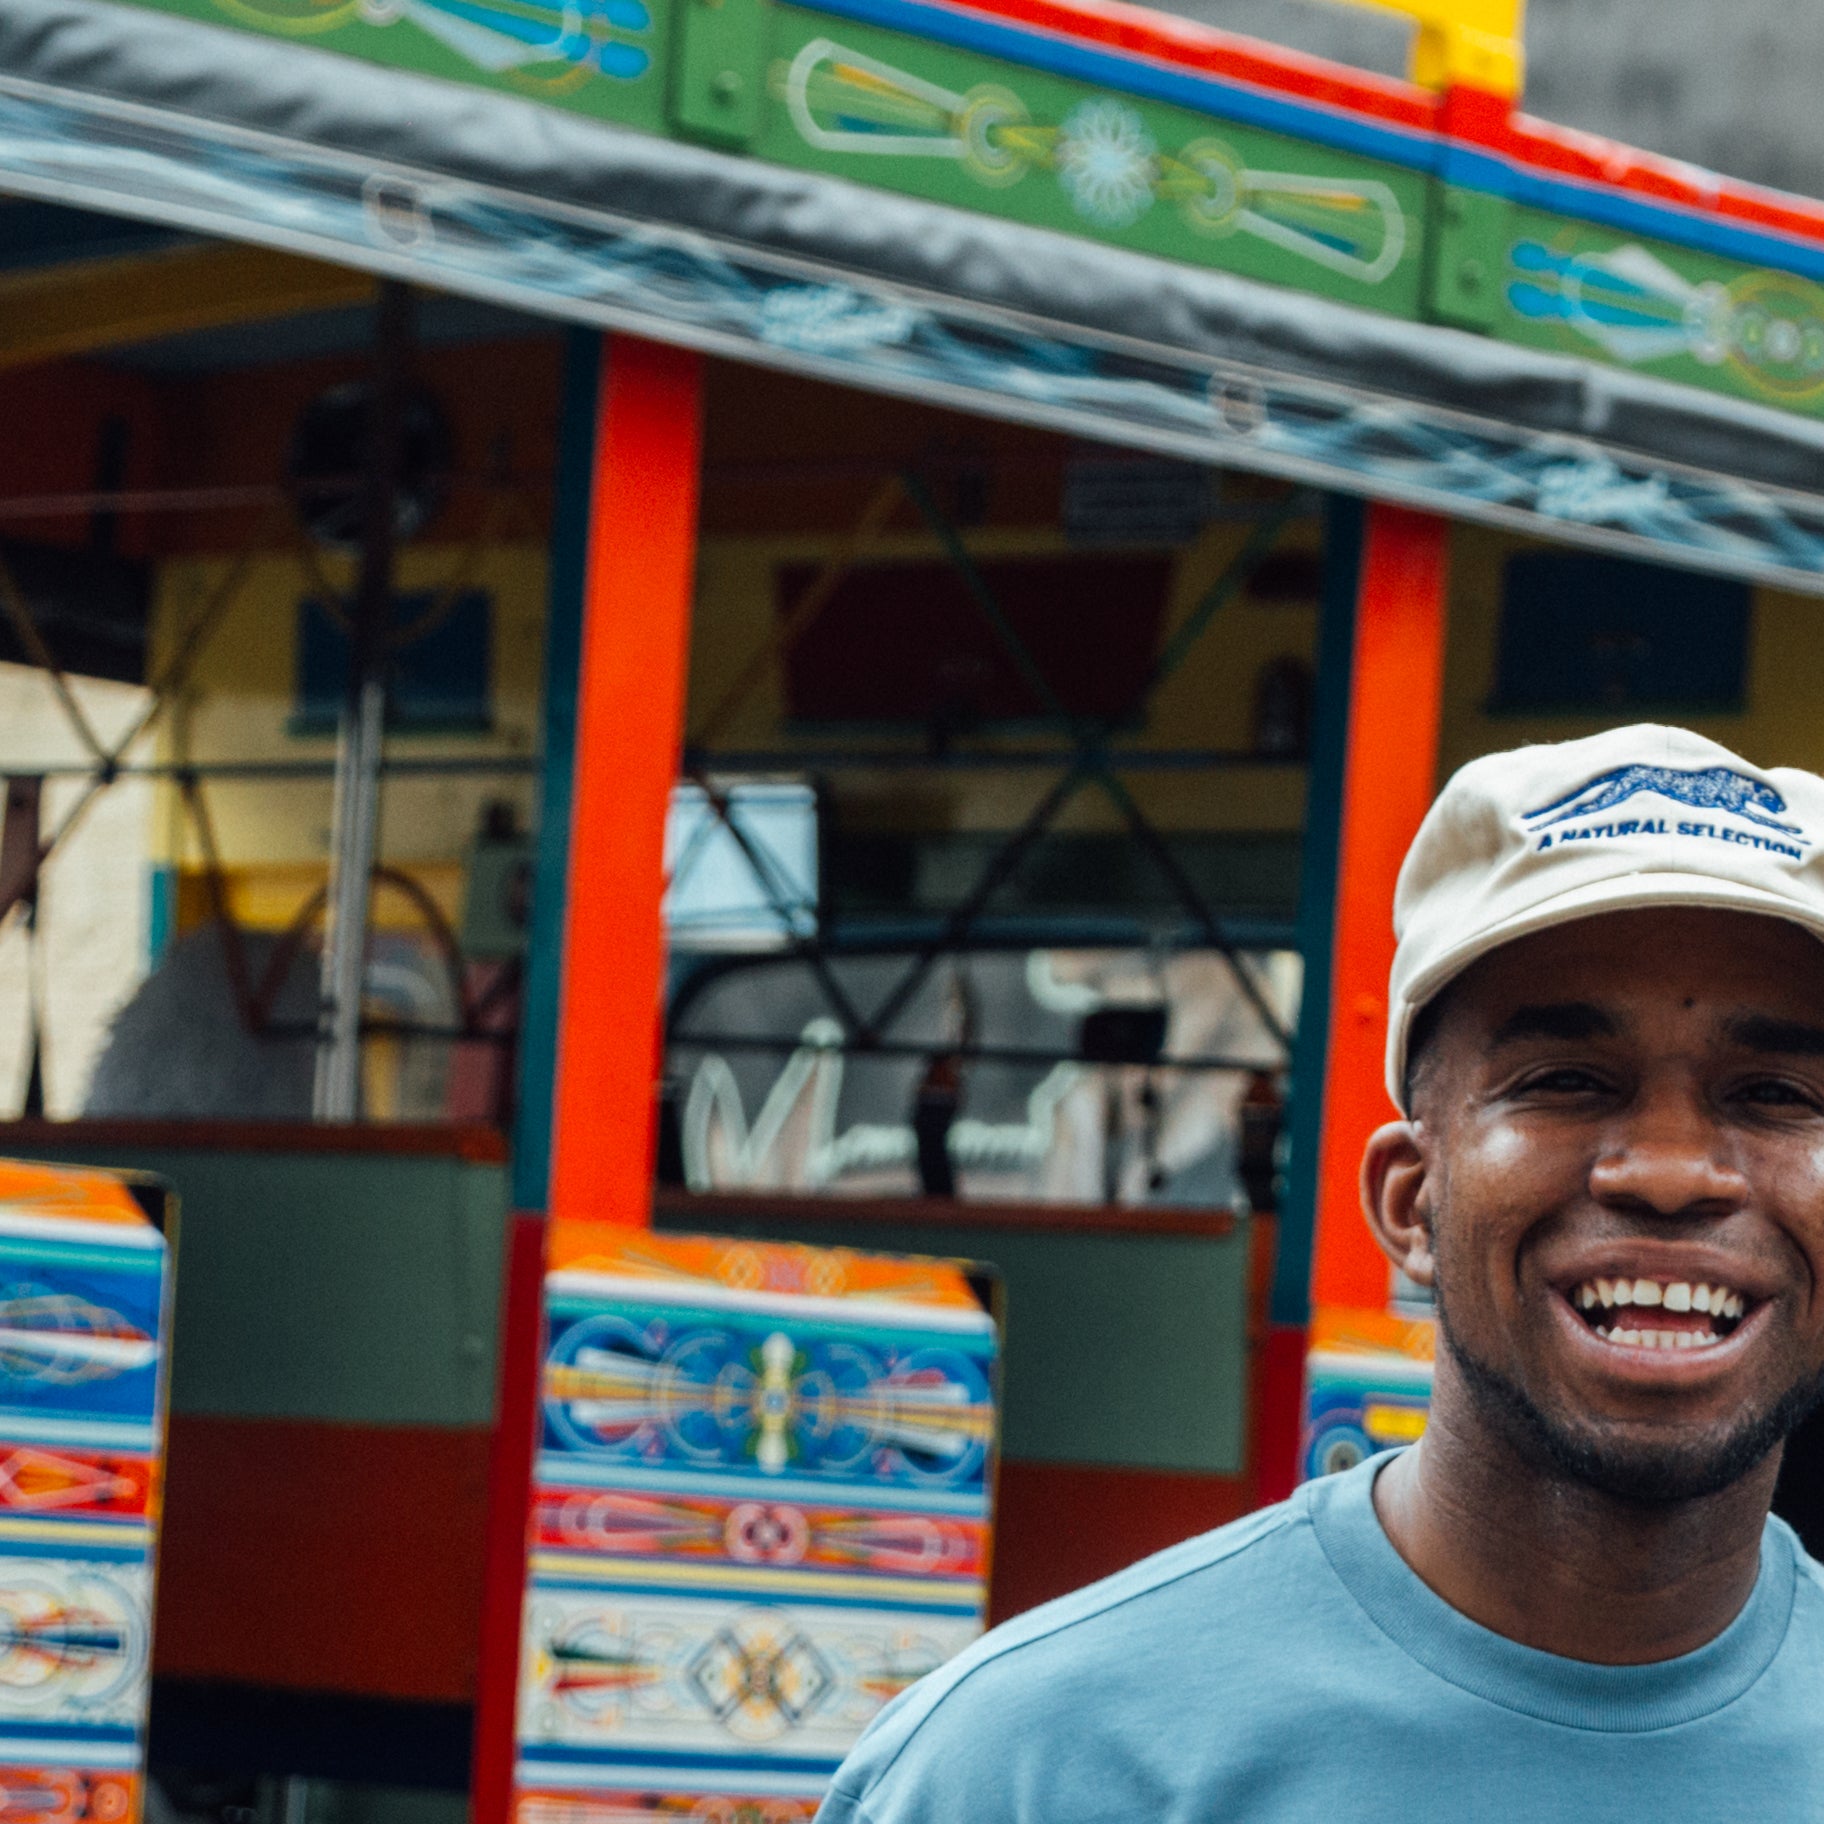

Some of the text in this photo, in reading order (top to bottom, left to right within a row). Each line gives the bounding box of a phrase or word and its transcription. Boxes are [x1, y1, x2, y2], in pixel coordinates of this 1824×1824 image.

[1538, 819, 1803, 860] A NATURAL SELECTION
